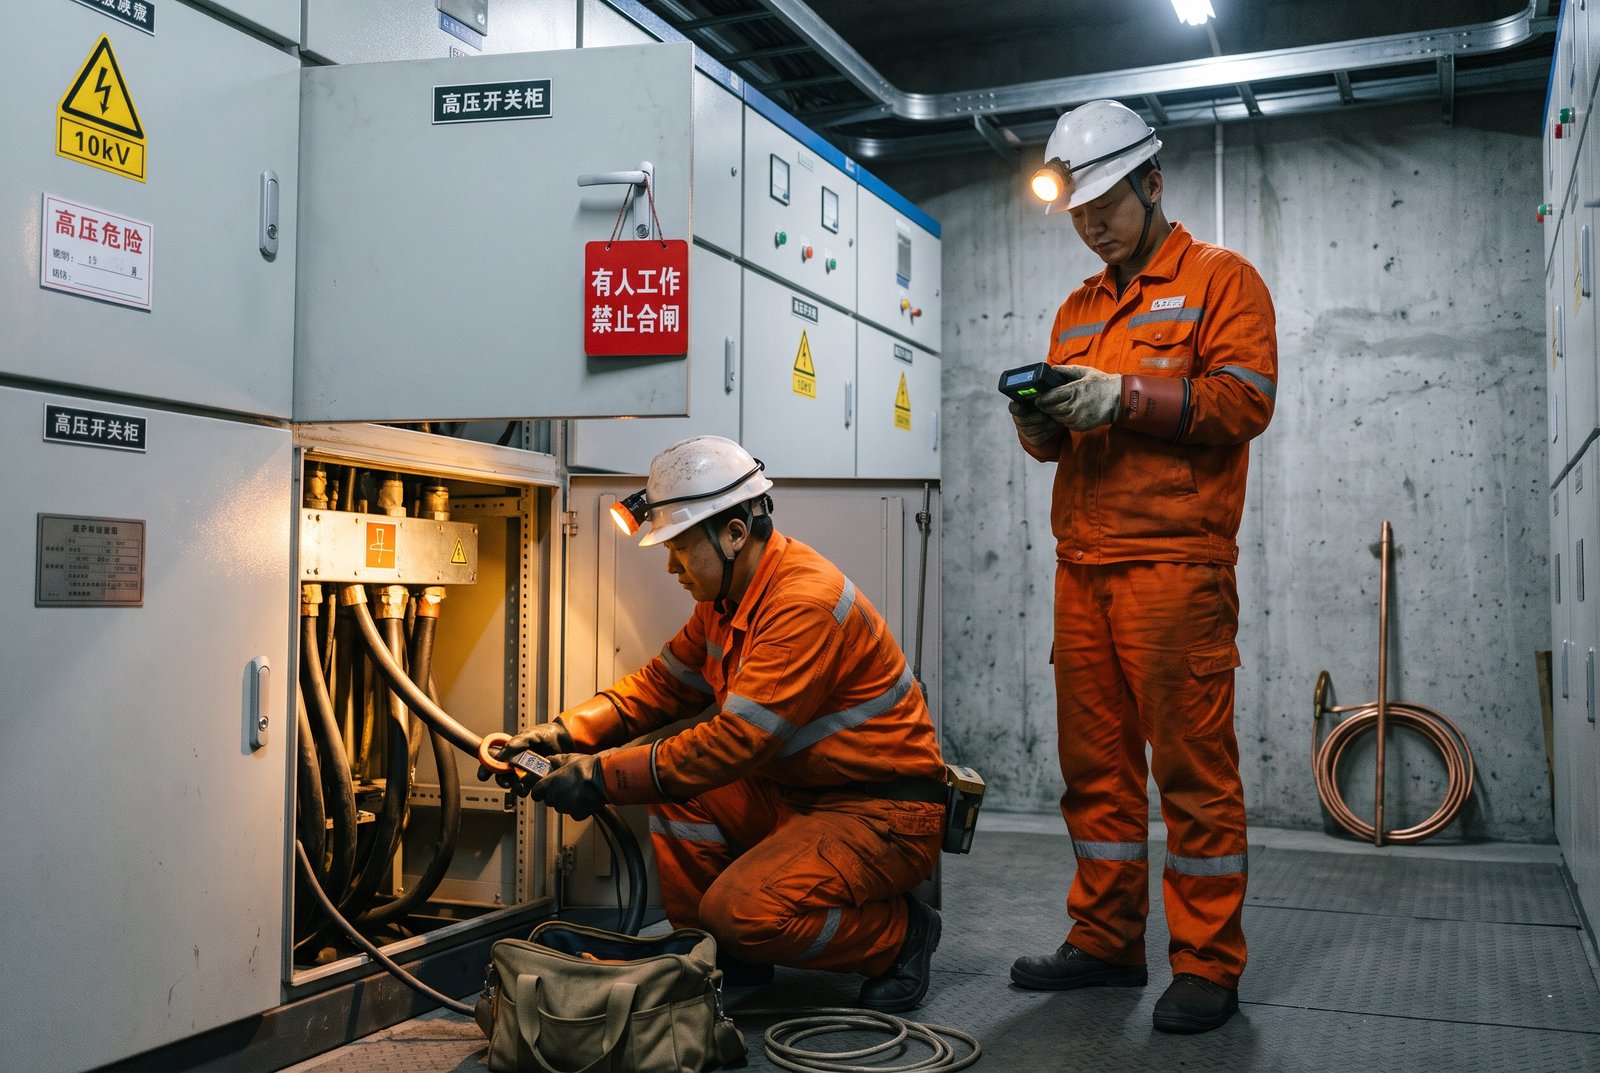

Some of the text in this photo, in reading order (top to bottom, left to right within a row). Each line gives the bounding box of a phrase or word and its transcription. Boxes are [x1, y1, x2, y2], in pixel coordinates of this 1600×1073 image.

[442, 87, 544, 114] 高压开关柜
[75, 131, 131, 166] 10kV
[55, 209, 143, 255] 高压危险
[591, 266, 681, 297] 有人工作
[591, 303, 680, 334] 禁止合闸
[55, 413, 139, 442] 高压开关柜
